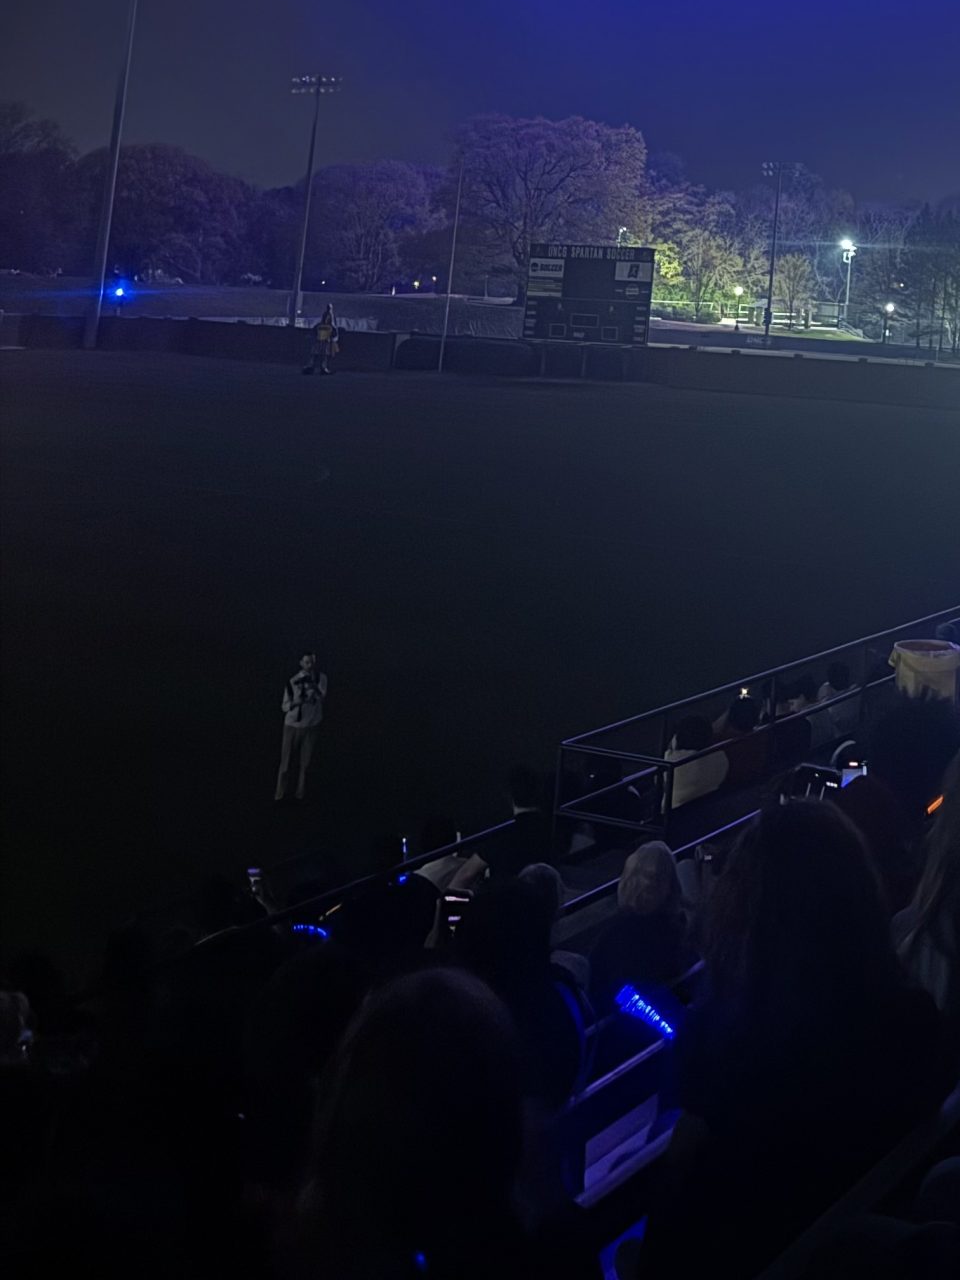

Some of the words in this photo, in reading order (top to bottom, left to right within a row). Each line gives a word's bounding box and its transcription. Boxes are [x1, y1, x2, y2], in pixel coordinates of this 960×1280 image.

[548, 246, 567, 258] UNCG
[571, 246, 604, 259] SPARTAN
[607, 248, 635, 260] SOCCER
